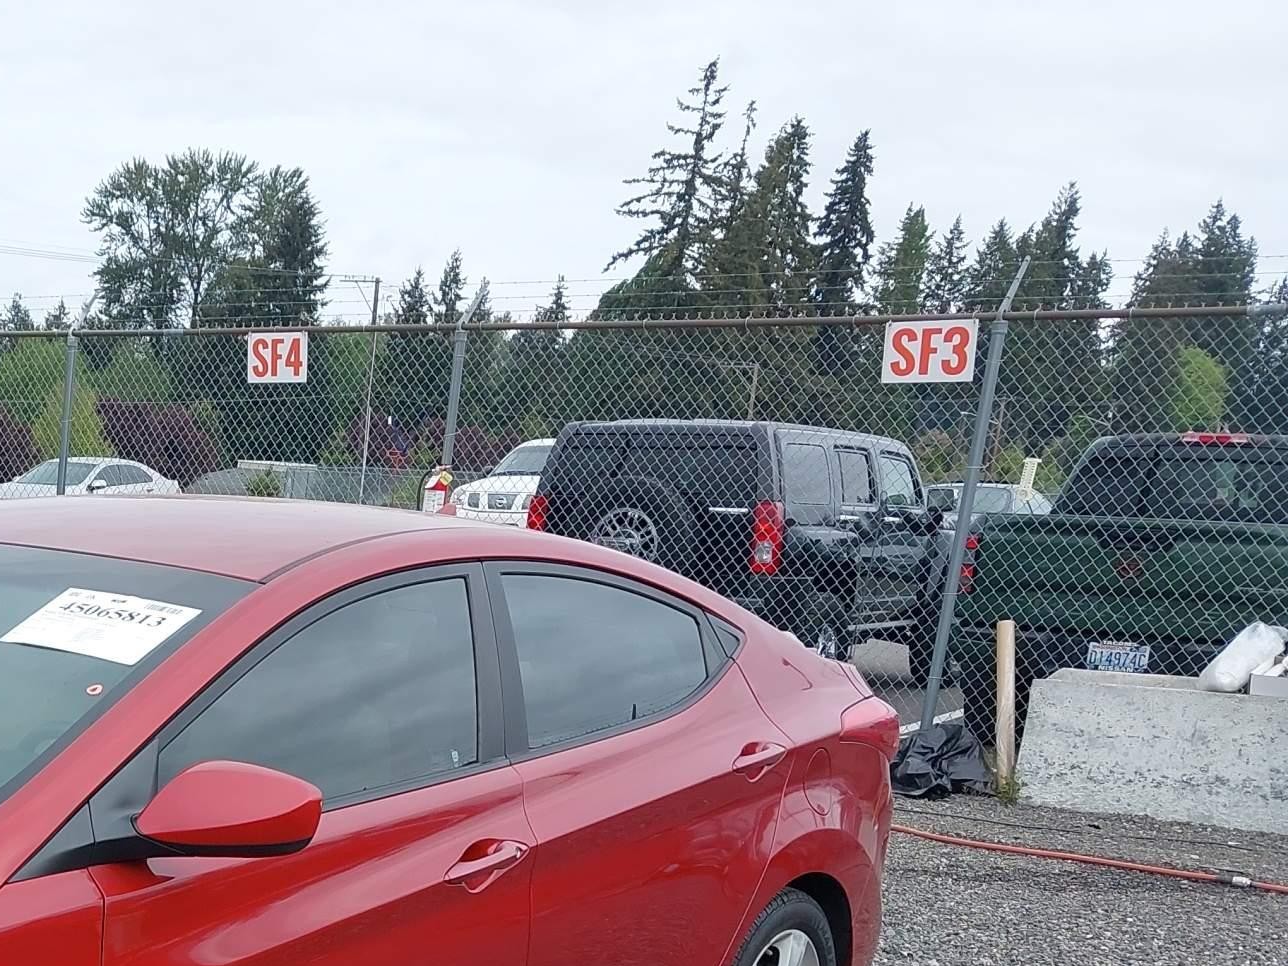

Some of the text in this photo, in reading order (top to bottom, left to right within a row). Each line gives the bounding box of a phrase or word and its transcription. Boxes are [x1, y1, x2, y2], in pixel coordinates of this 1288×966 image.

[252, 338, 303, 377] SF4
[890, 326, 970, 377] SF3
[59, 601, 167, 628] 45065813
[1098, 665, 1133, 673] NISSAN
